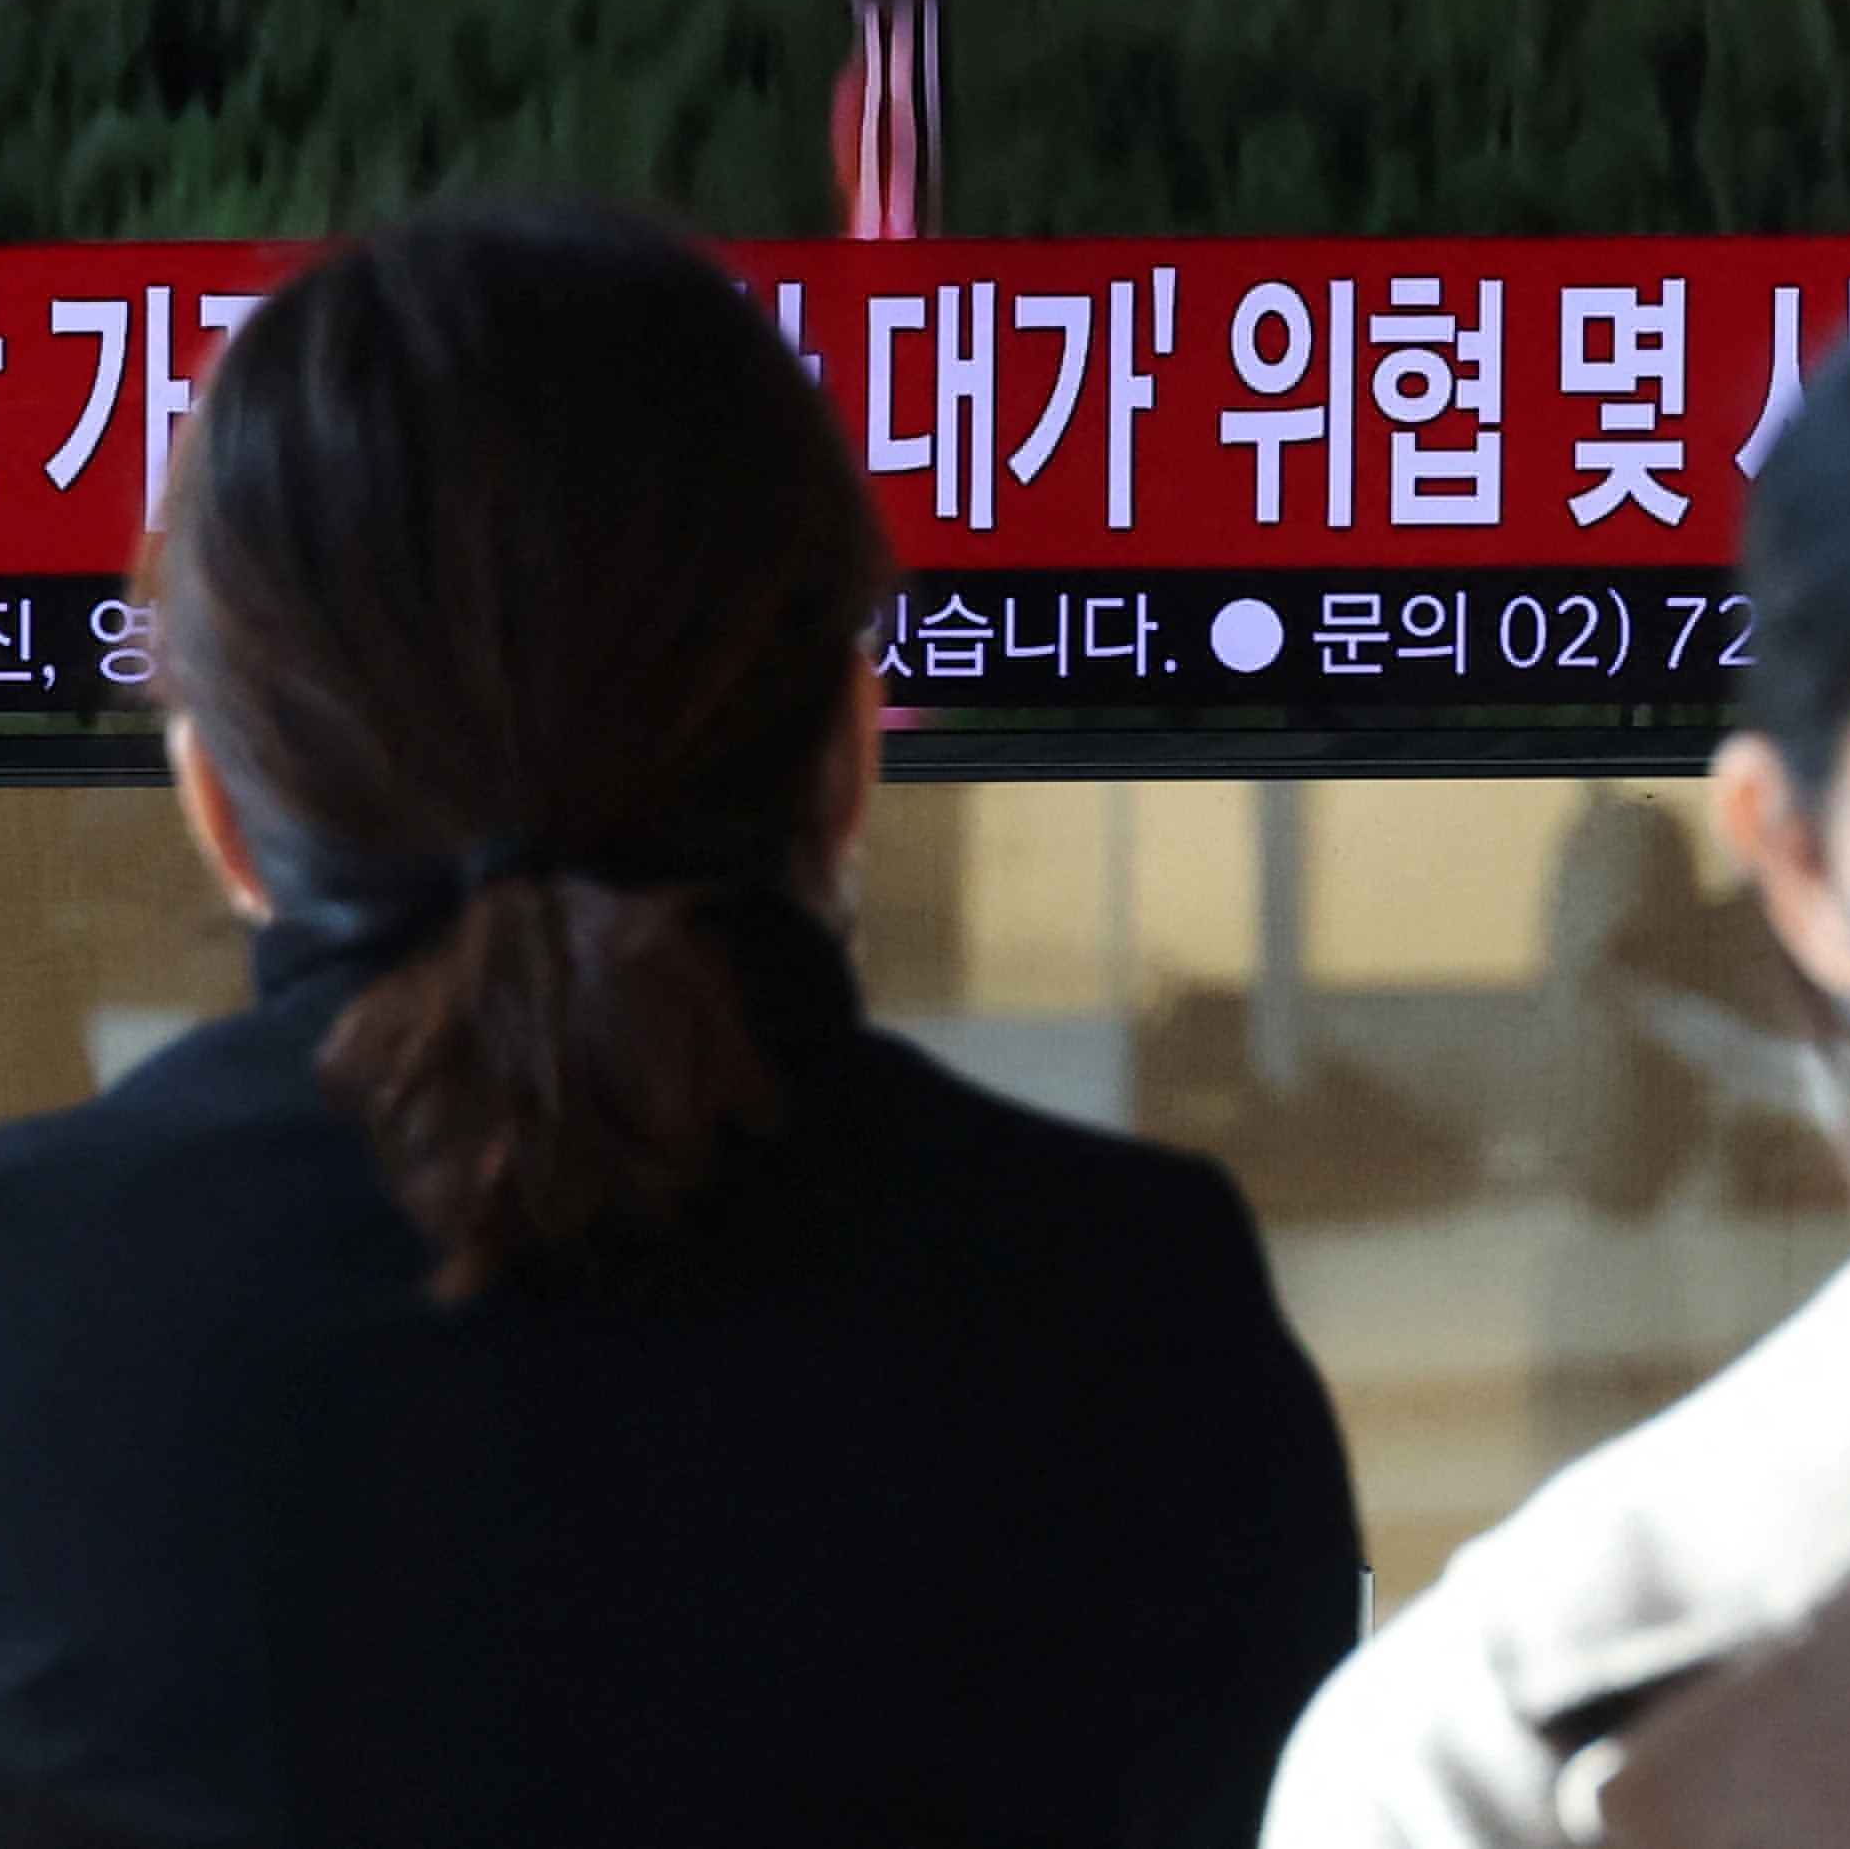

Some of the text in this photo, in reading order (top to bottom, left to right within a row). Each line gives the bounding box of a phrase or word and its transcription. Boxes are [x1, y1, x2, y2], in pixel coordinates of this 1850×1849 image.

[45, 284, 249, 534] 가
[867, 266, 1177, 530] 대가'
[1220, 277, 1504, 528] 위협
[1560, 277, 1689, 527] 몇
[1311, 590, 1468, 676] 문의
[1499, 587, 1631, 676] 02)
